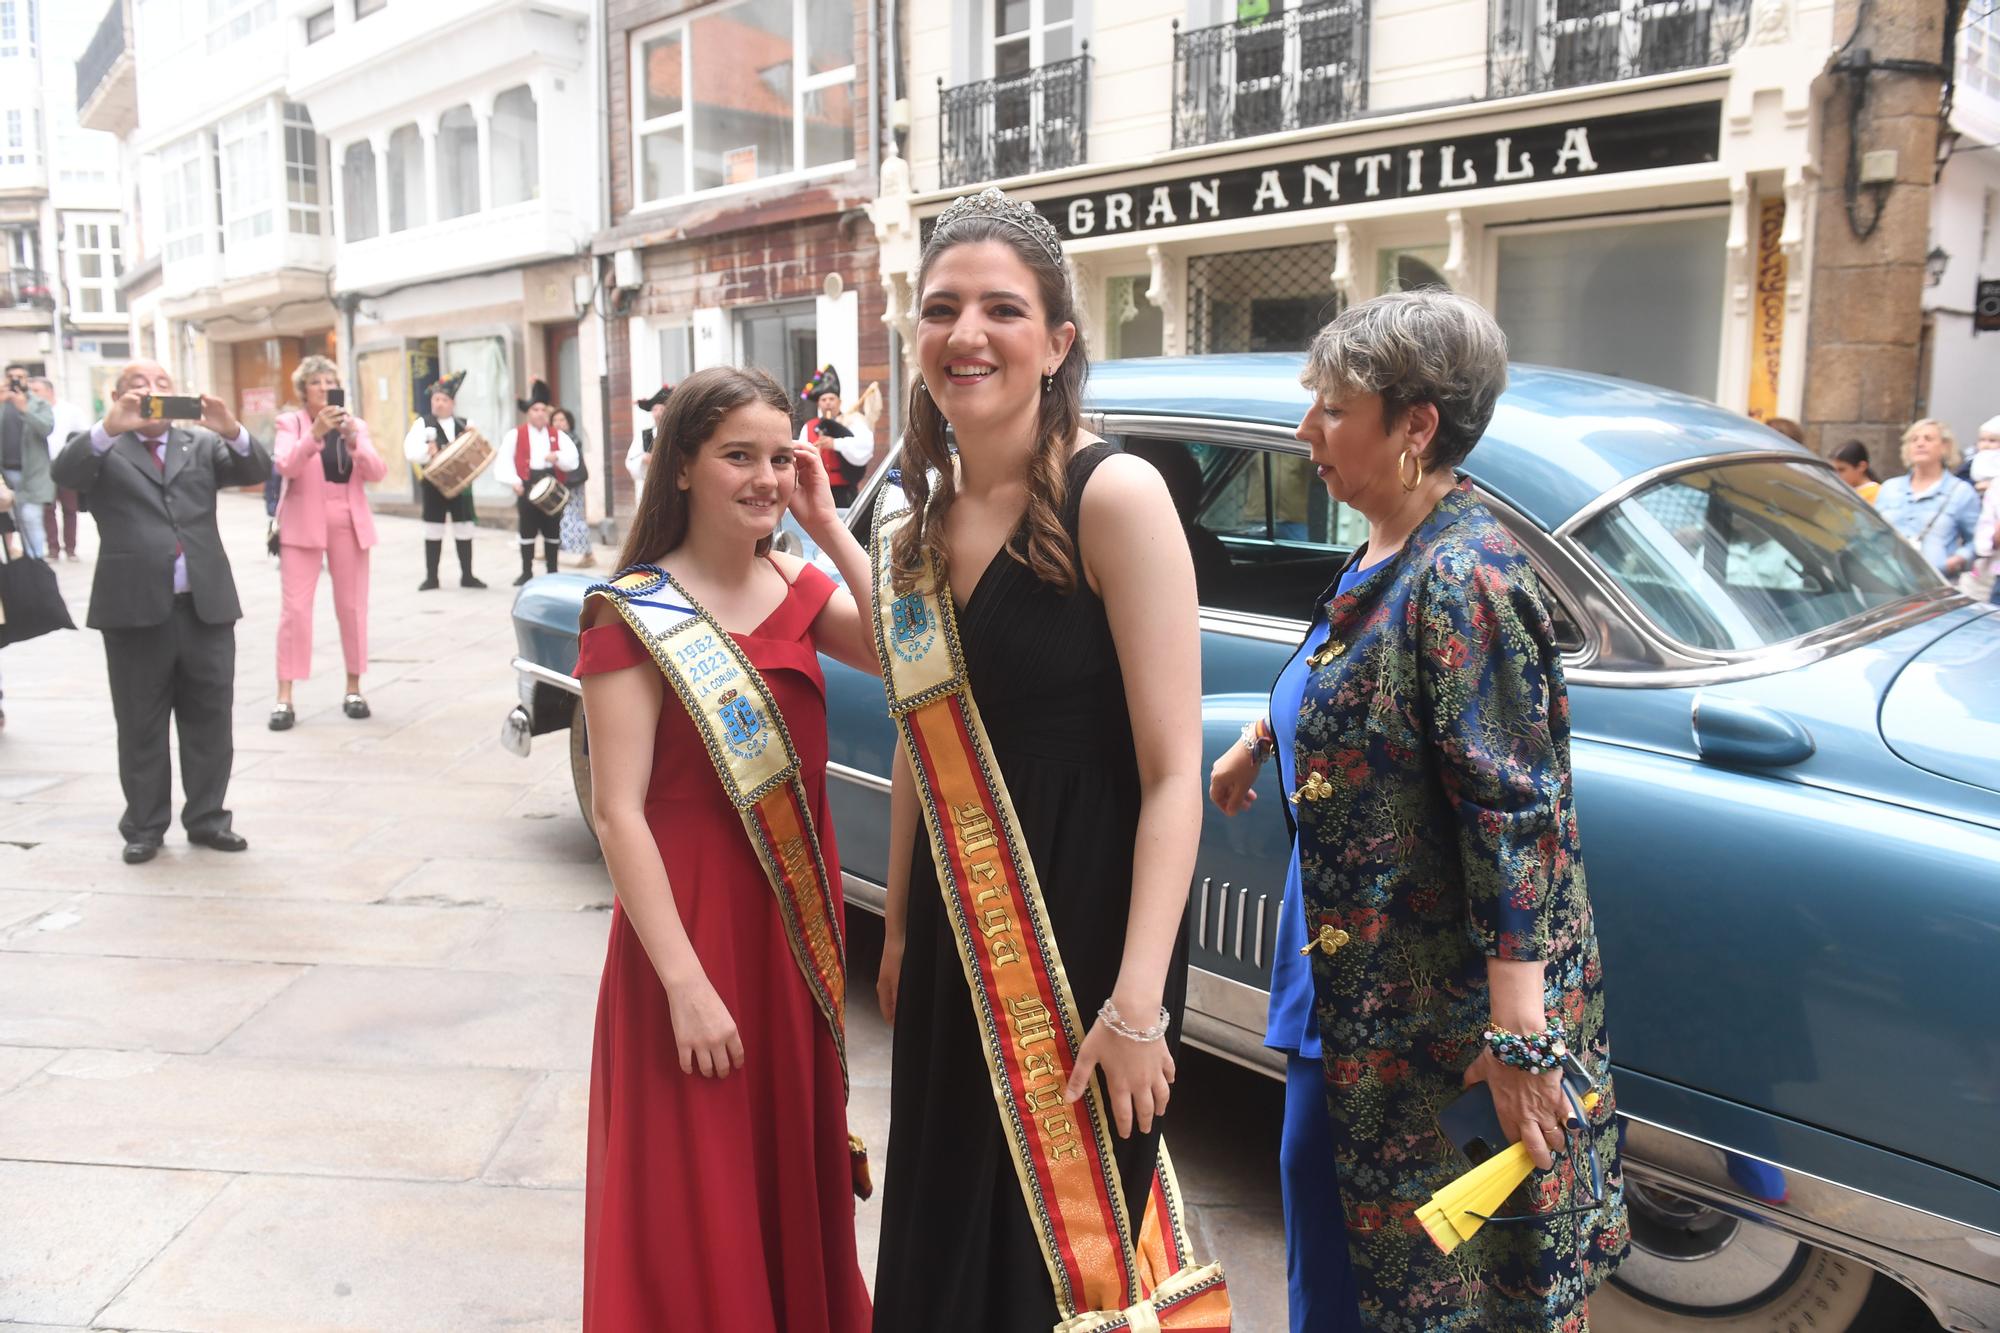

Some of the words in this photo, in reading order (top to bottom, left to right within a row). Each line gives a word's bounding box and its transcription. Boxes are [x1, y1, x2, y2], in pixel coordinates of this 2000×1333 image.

[1067, 178, 1221, 236] GRAN
[1252, 126, 1599, 212] ANTILLA
[927, 608, 937, 633] JUAN
[676, 635, 717, 665] 1962
[923, 635, 935, 654] SAN
[689, 651, 729, 683] 2023
[697, 686, 711, 698] LA
[710, 667, 740, 690] CORUÑA
[953, 802, 1021, 968] Meiga
[1006, 993, 1079, 1161] Mayor
